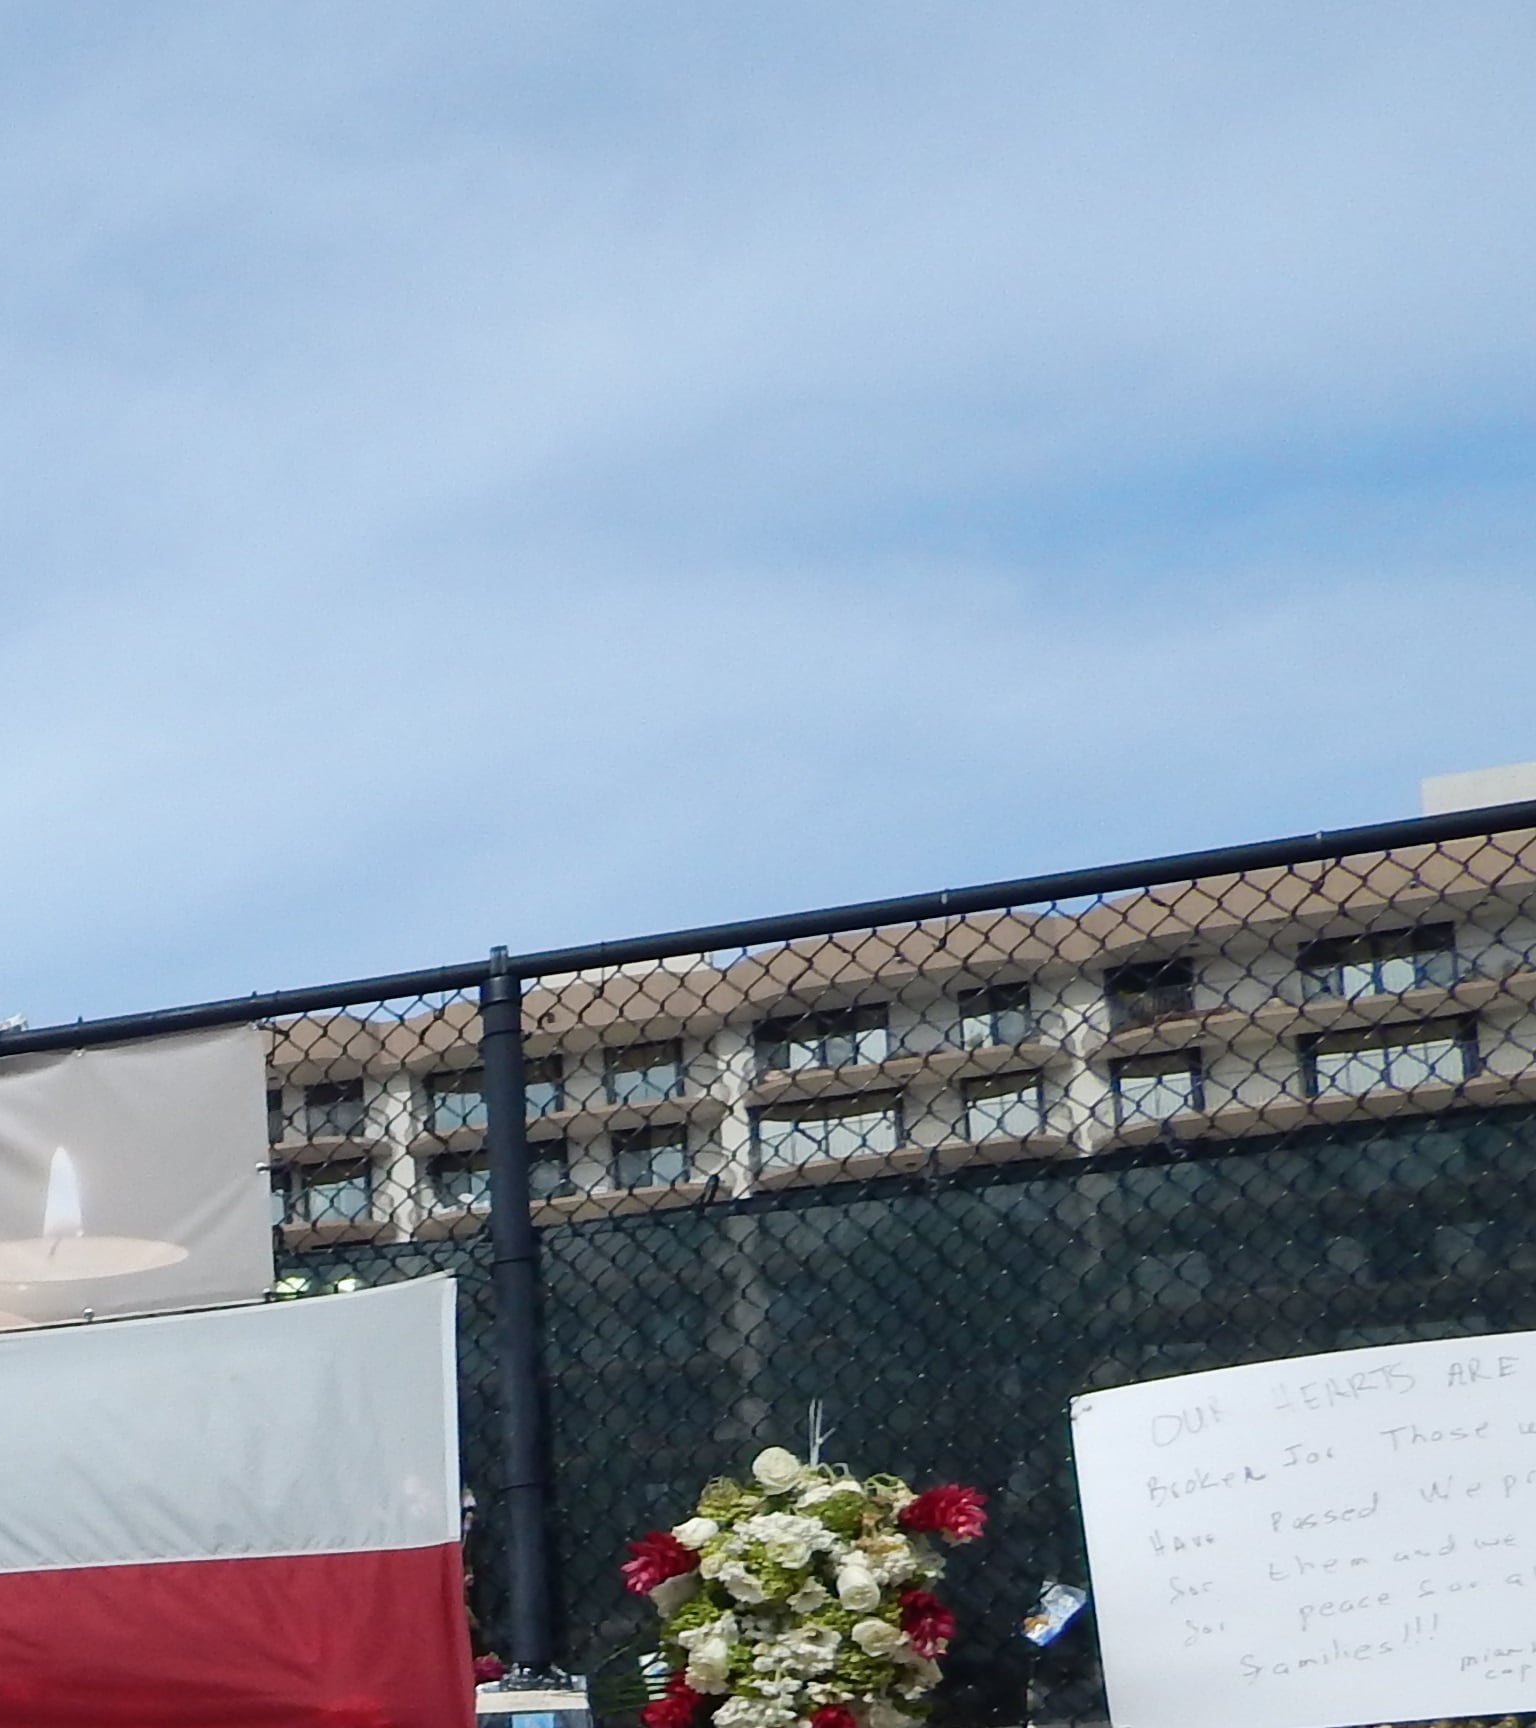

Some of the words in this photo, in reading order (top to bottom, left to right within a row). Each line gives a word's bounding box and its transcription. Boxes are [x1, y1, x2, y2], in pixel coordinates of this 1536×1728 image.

[1448, 1356, 1520, 1387] ARE
[1380, 1421, 1489, 1452] Those
[1298, 1591, 1391, 1632] peace
